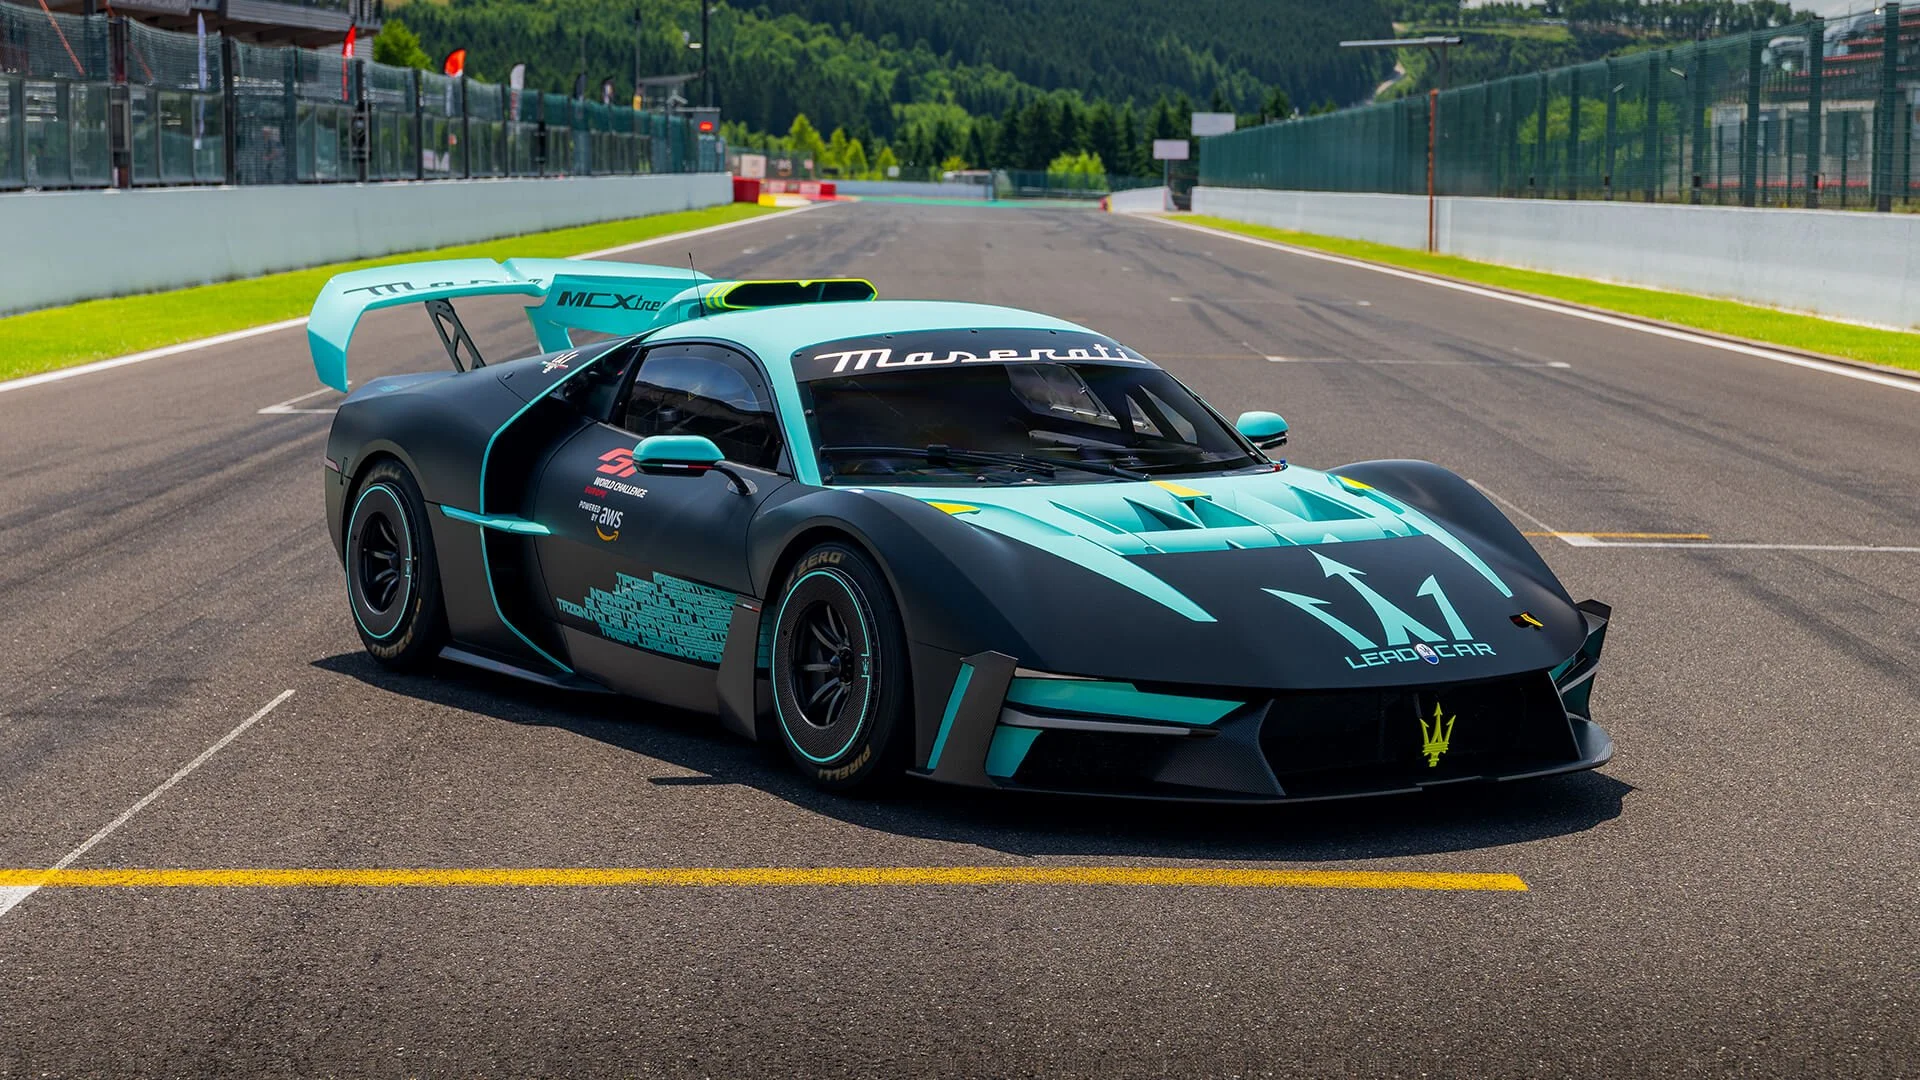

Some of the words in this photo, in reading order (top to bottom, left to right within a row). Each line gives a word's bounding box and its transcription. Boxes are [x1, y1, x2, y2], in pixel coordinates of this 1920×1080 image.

[557, 291, 666, 311] MCXtre
[814, 343, 1146, 372] Maserati
[593, 476, 615, 490] WORLD
[613, 482, 648, 498] CHALLENGE
[578, 500, 601, 513] POWERED
[591, 513, 598, 522] BY
[599, 507, 624, 529] aws
[1345, 648, 1420, 669] LEAD
[1434, 643, 1497, 657] CAR
[818, 743, 871, 781] PIRELLI
